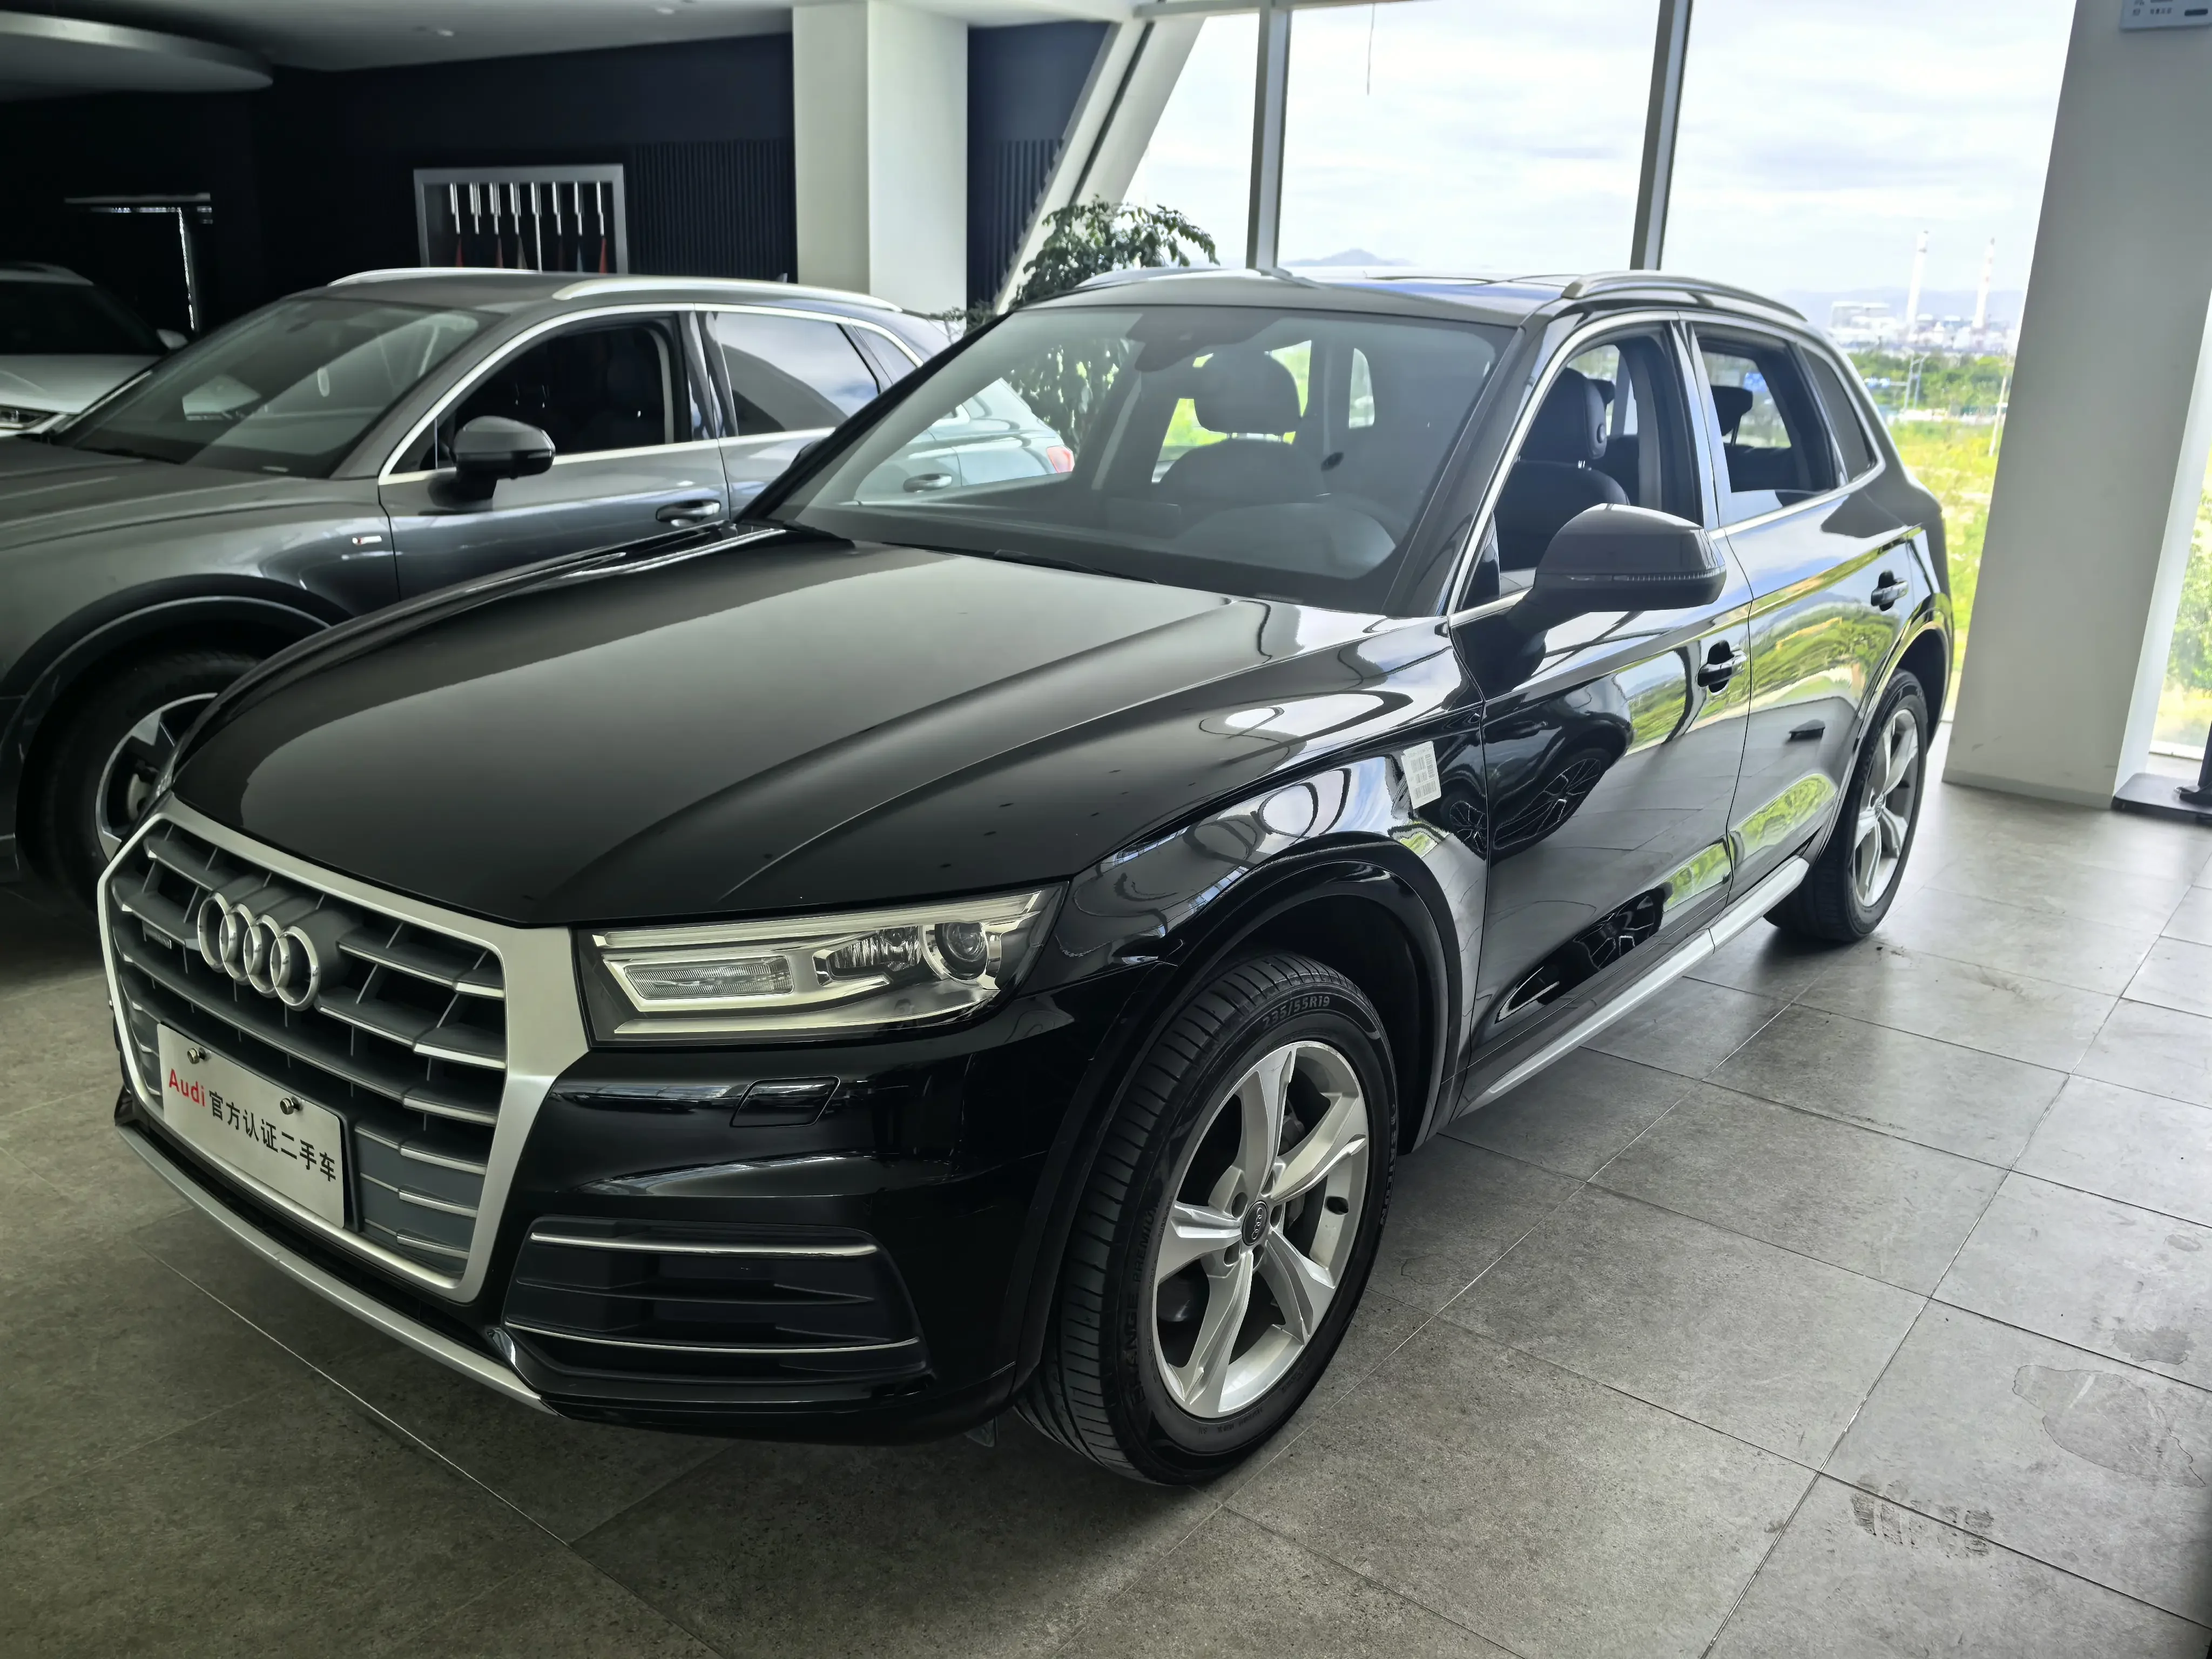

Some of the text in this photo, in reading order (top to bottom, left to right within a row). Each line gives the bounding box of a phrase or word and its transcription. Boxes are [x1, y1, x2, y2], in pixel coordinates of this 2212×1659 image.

[1262, 995, 1330, 1030] 235/55R19
[168, 1068, 336, 1182] Audi 官方认证二手车
